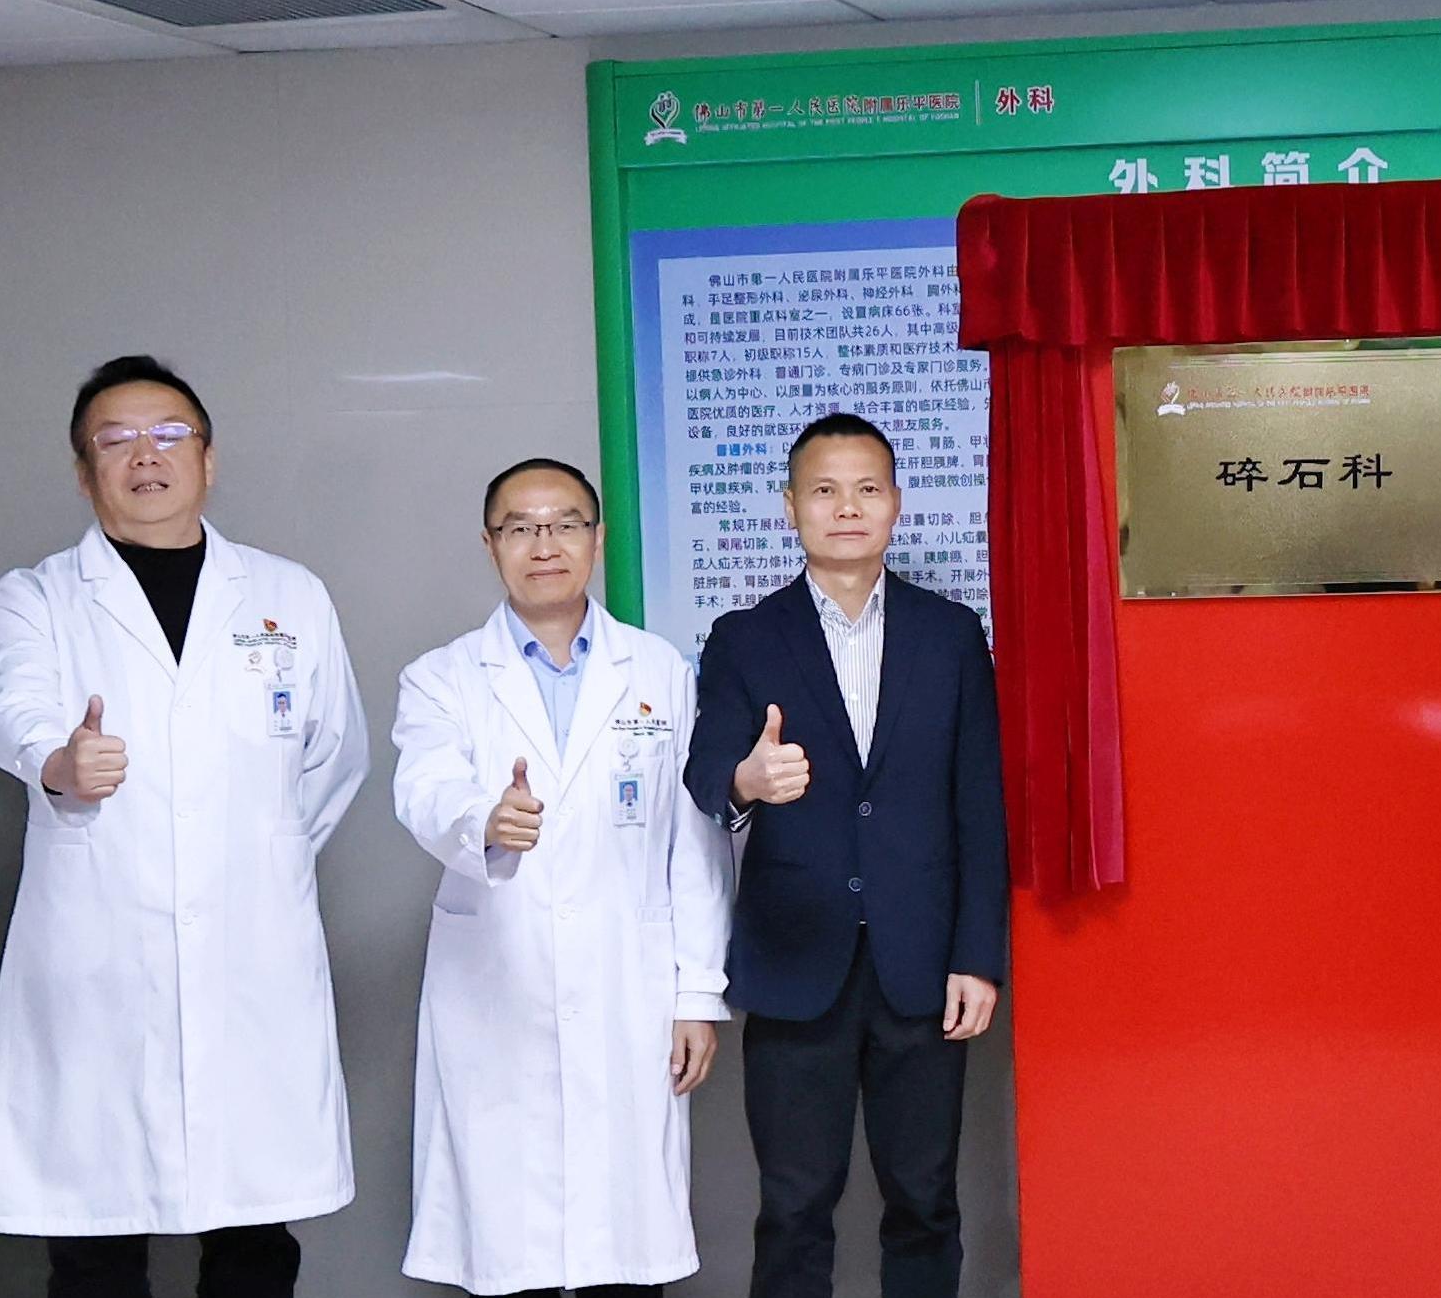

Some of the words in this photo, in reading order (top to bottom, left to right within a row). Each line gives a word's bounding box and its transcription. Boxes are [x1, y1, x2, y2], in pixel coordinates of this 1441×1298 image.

[996, 86, 1054, 114] 外科
[1108, 146, 1389, 195] 外科简介
[1215, 452, 1393, 492] 碎石科
